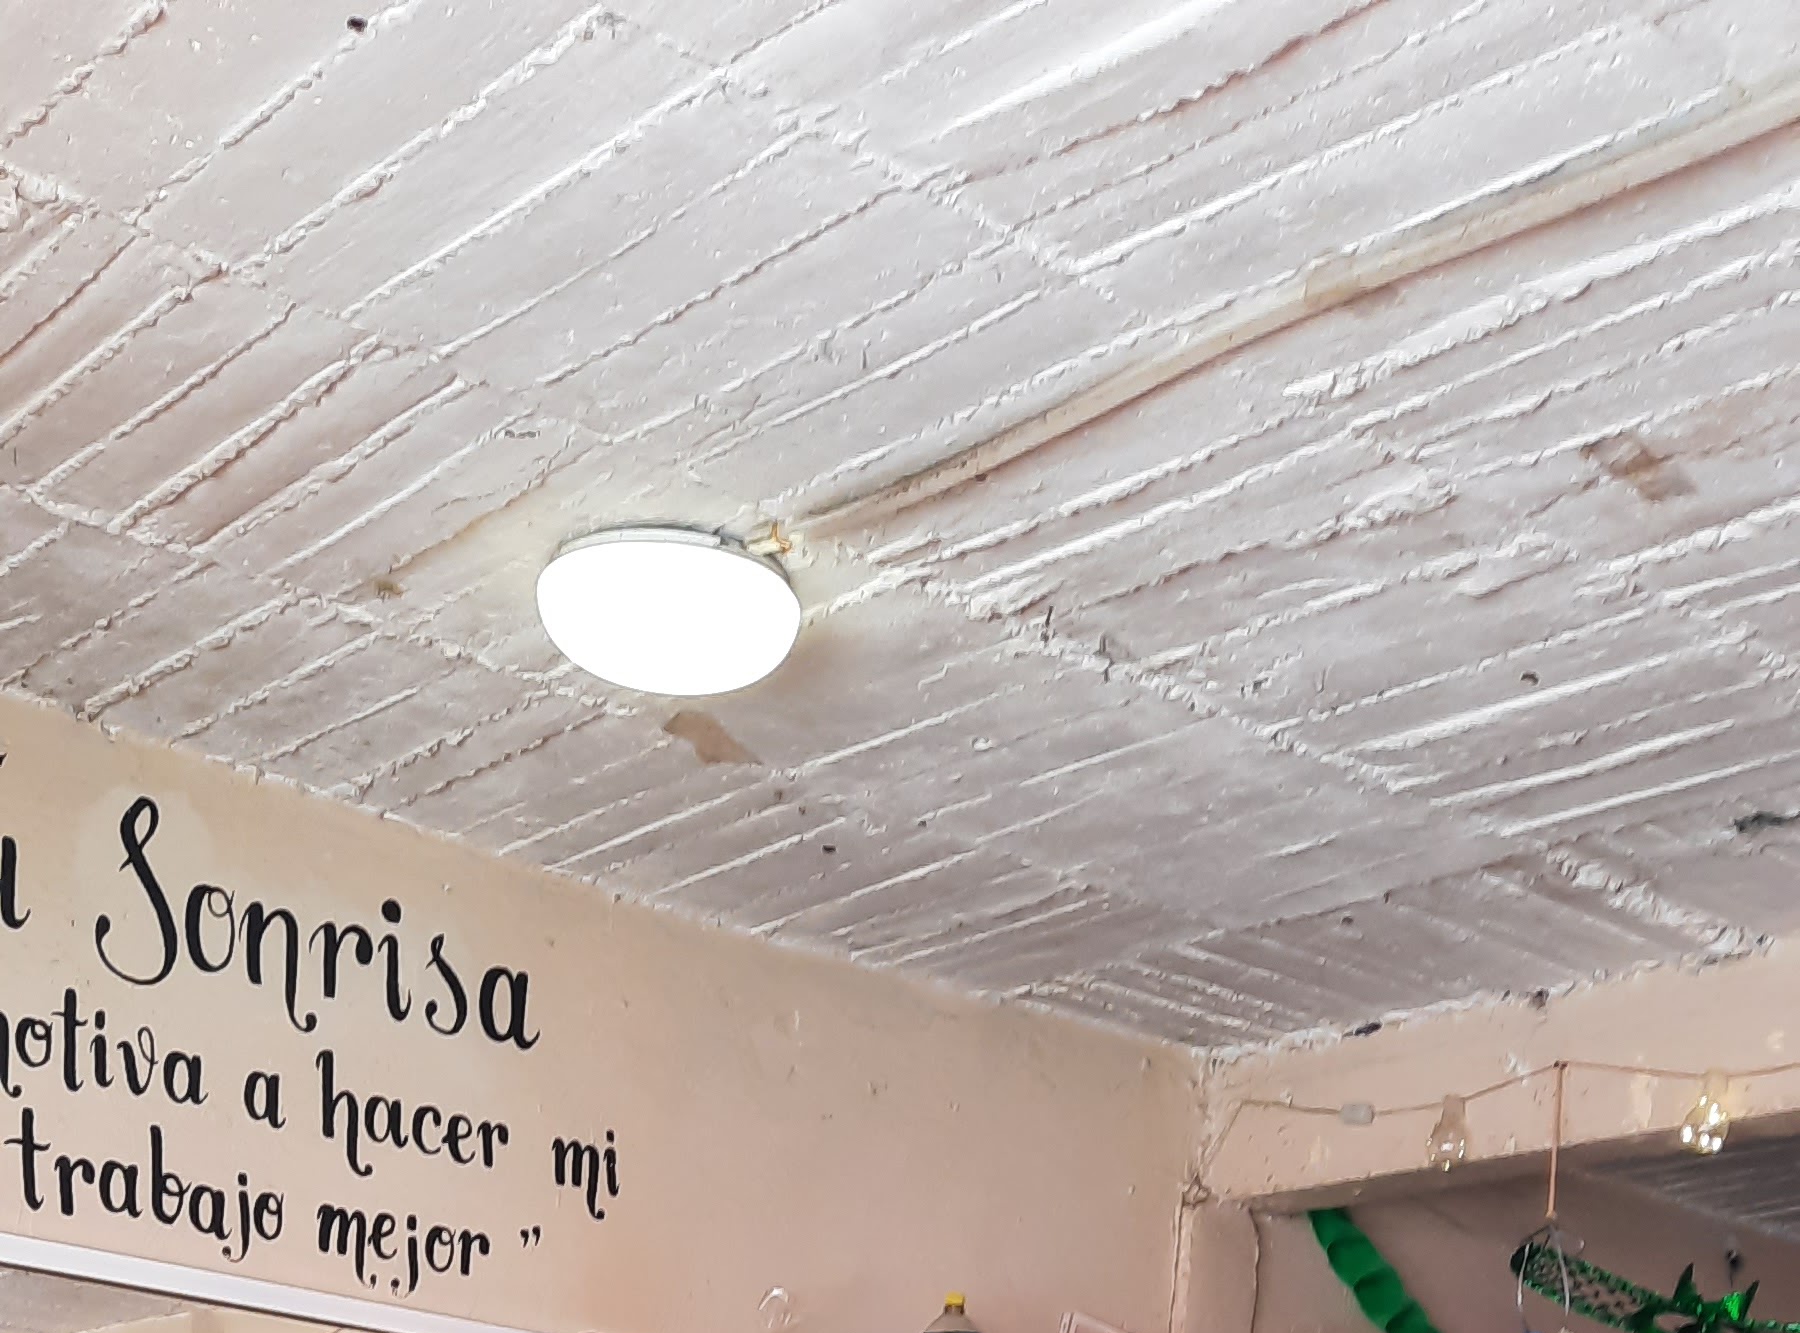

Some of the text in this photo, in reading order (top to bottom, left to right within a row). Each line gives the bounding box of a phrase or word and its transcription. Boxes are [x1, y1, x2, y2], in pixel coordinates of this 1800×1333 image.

[94, 796, 541, 1051] Sonrisa
[3, 1107, 285, 1261] trabajo
[316, 1203, 491, 1293] mejor
[243, 1071, 287, 1129] a
[315, 1049, 510, 1177] hacer
[551, 1129, 621, 1220] mi
